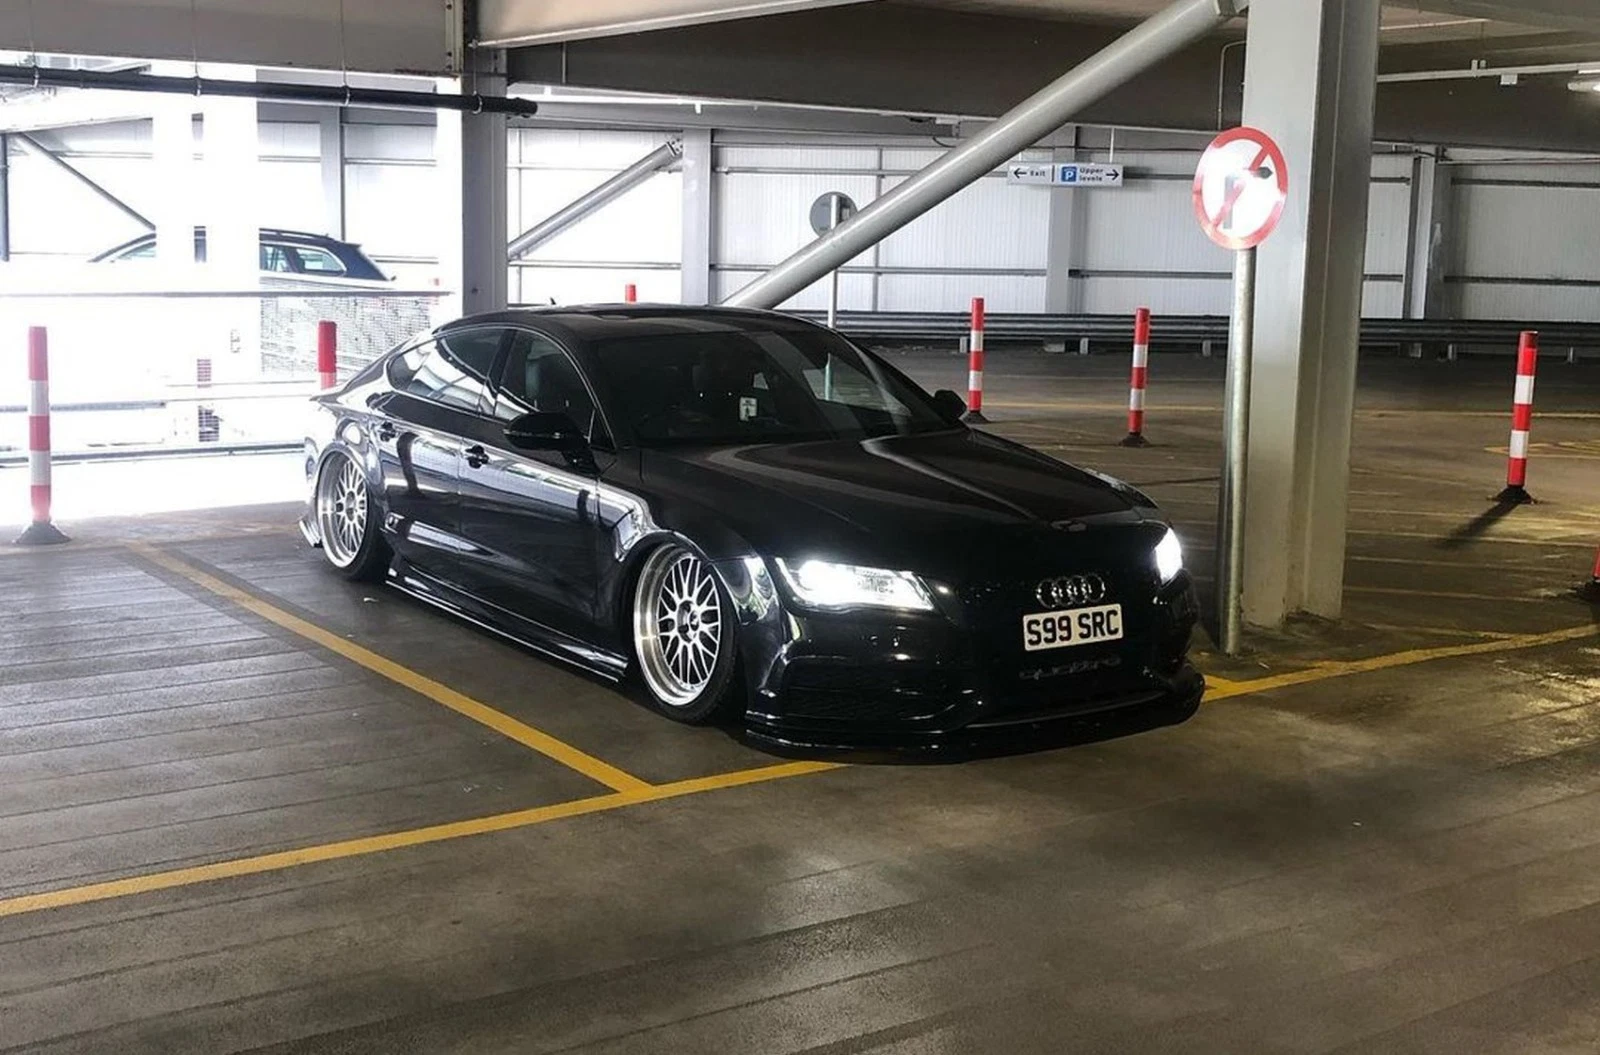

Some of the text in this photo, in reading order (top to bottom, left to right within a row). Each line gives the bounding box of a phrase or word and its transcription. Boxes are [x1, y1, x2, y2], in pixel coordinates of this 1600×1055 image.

[1030, 169, 1046, 177] Exit
[1080, 167, 1104, 175] Upper
[1080, 174, 1103, 182] levels
[1026, 609, 1119, 646] S99 SRC
